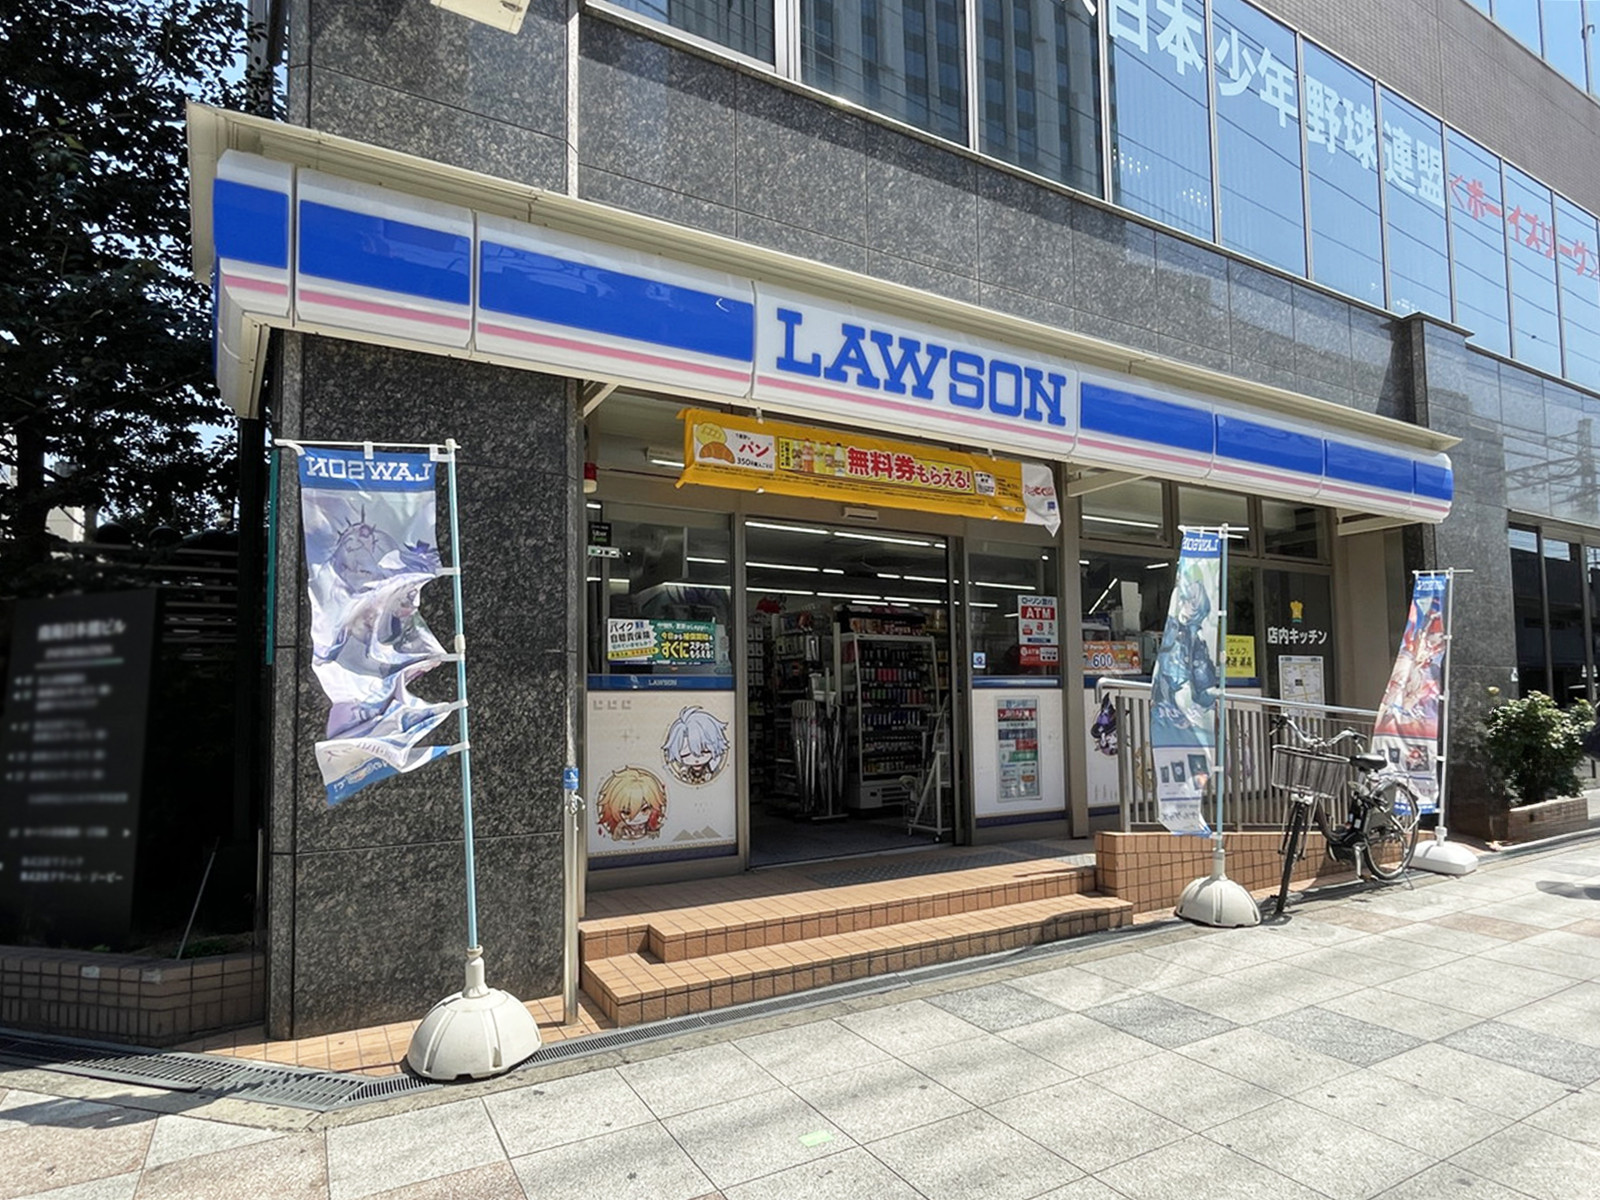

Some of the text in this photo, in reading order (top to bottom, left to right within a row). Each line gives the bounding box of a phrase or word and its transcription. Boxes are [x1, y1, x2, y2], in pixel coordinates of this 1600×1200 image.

[1109, 0, 1445, 208] 日本少年野球連盟
[776, 308, 1067, 426] LAWSON
[739, 441, 769, 458] パン
[847, 447, 971, 490] 無料券もらえる!
[1026, 607, 1051, 619] ATM
[610, 622, 634, 633] バイク
[1267, 626, 1328, 645] 店内キッチン
[661, 641, 689, 658] すぐに
[1093, 654, 1113, 667] 600
[648, 678, 678, 686] LAWSON
